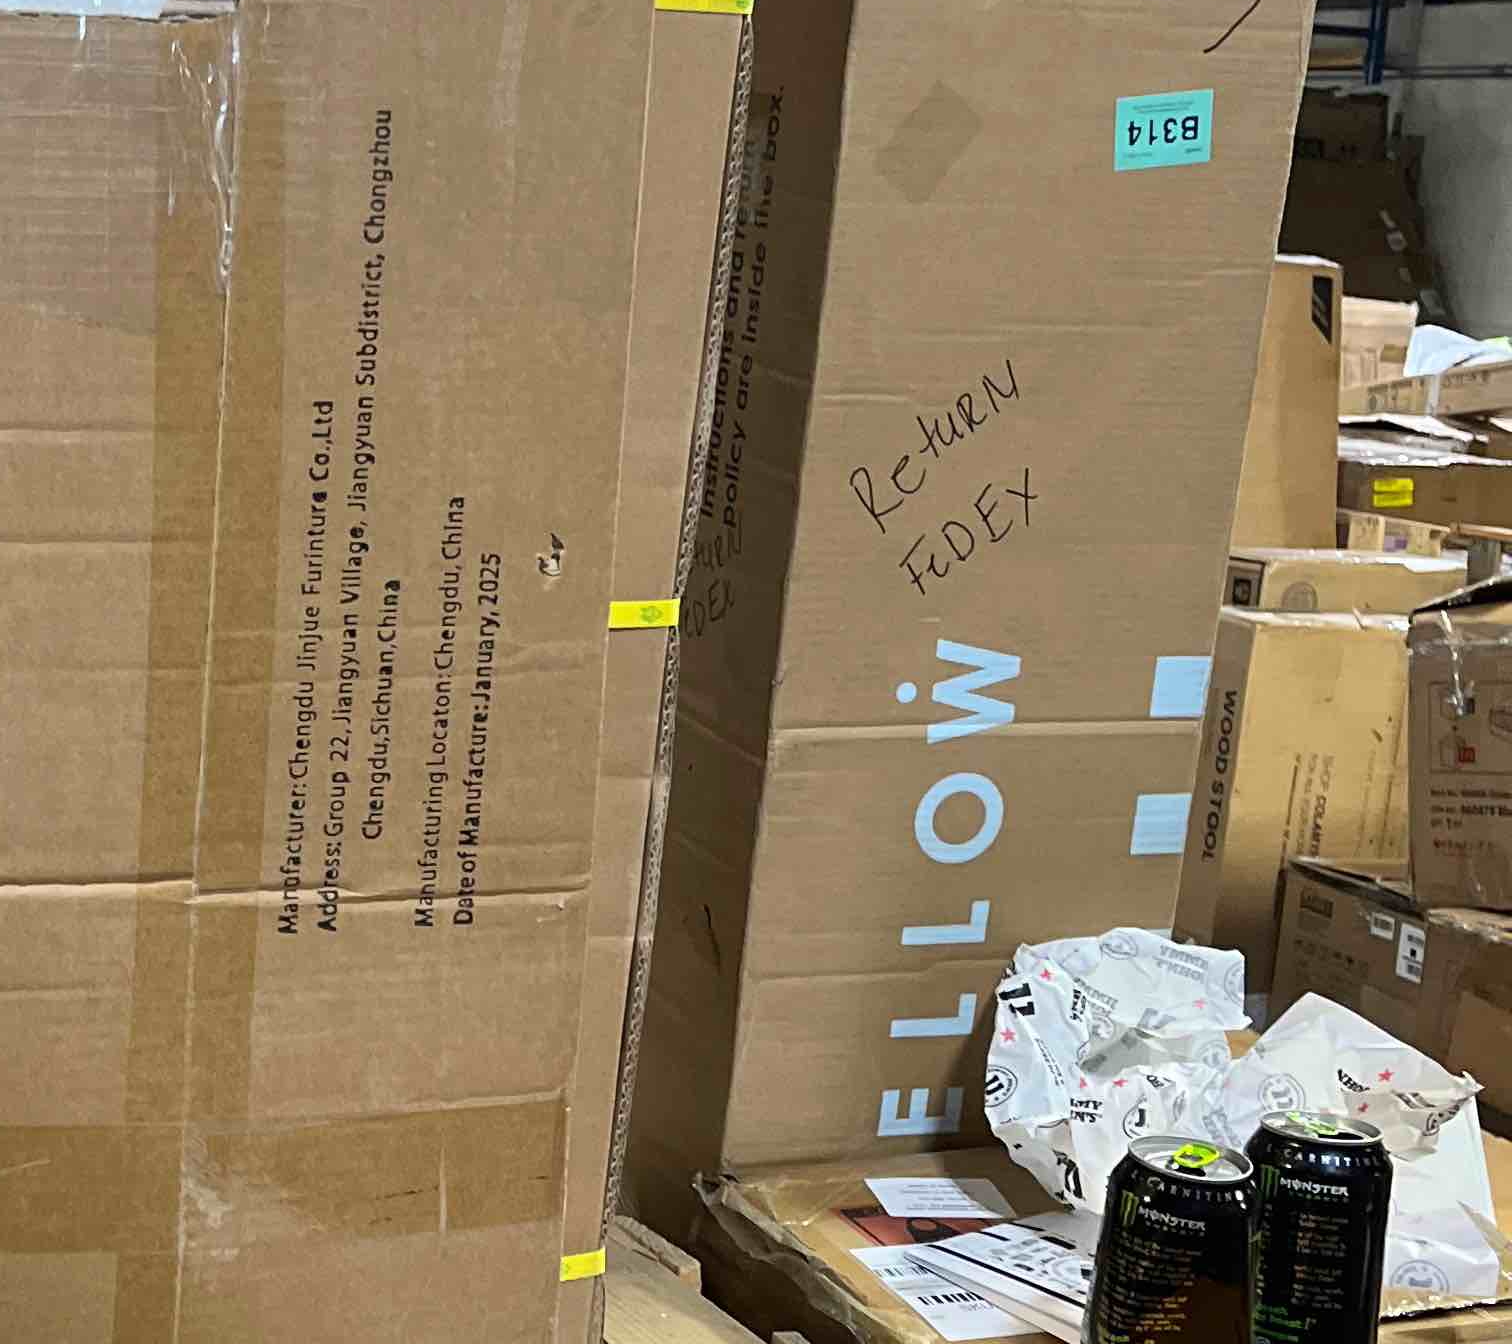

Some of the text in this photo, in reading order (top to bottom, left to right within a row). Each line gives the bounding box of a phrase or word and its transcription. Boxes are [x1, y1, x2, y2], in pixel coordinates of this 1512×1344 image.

[364, 109, 393, 244] Chongzhou
[1127, 115, 1199, 146] B314
[355, 253, 385, 386] Subdistrict,
[741, 242, 767, 343] inside
[736, 355, 753, 411] are
[347, 396, 375, 511] Jiangyuan
[723, 429, 747, 528] policy
[302, 491, 328, 595] Furinture
[340, 521, 369, 604] Village,
[297, 607, 323, 671] Jinjue
[1200, 689, 1238, 863] WOOD STOOL
[414, 771, 449, 928] Manufacturing
[1139, 1206, 1206, 1231] MONSTER
[1280, 1177, 1349, 1197] MONSTER
